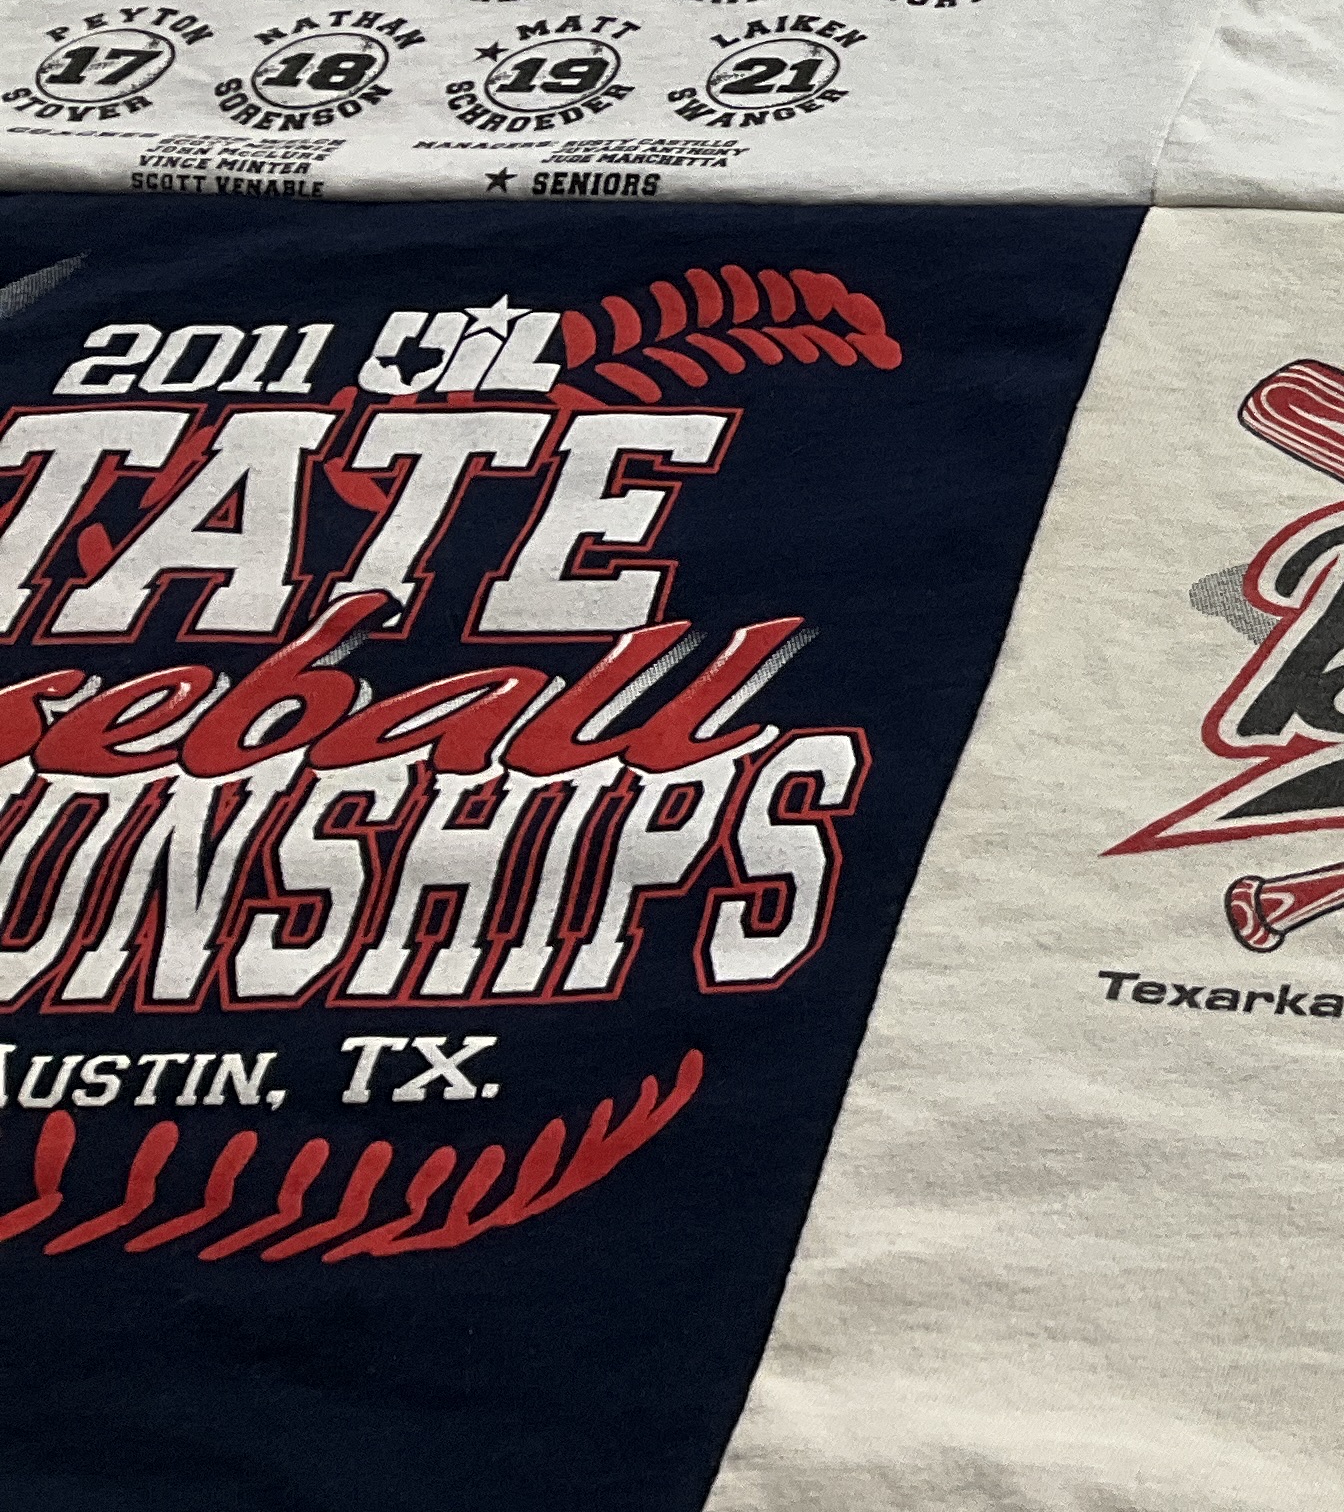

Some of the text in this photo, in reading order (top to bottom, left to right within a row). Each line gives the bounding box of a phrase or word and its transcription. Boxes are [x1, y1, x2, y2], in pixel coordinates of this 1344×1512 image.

[262, 53, 377, 91] 18
[496, 57, 609, 94] 19
[719, 58, 824, 95] 21
[215, 63, 392, 131] SORENSON
[446, 65, 635, 132] SCHROEDER
[668, 69, 849, 128] SWANGER
[138, 155, 312, 175] VINCE MINTER
[532, 172, 661, 196] SENIORS
[131, 172, 325, 198] SCOTT VENABLE
[52, 304, 563, 396] 2011 UIL
[341, 1036, 500, 1102] TX.
